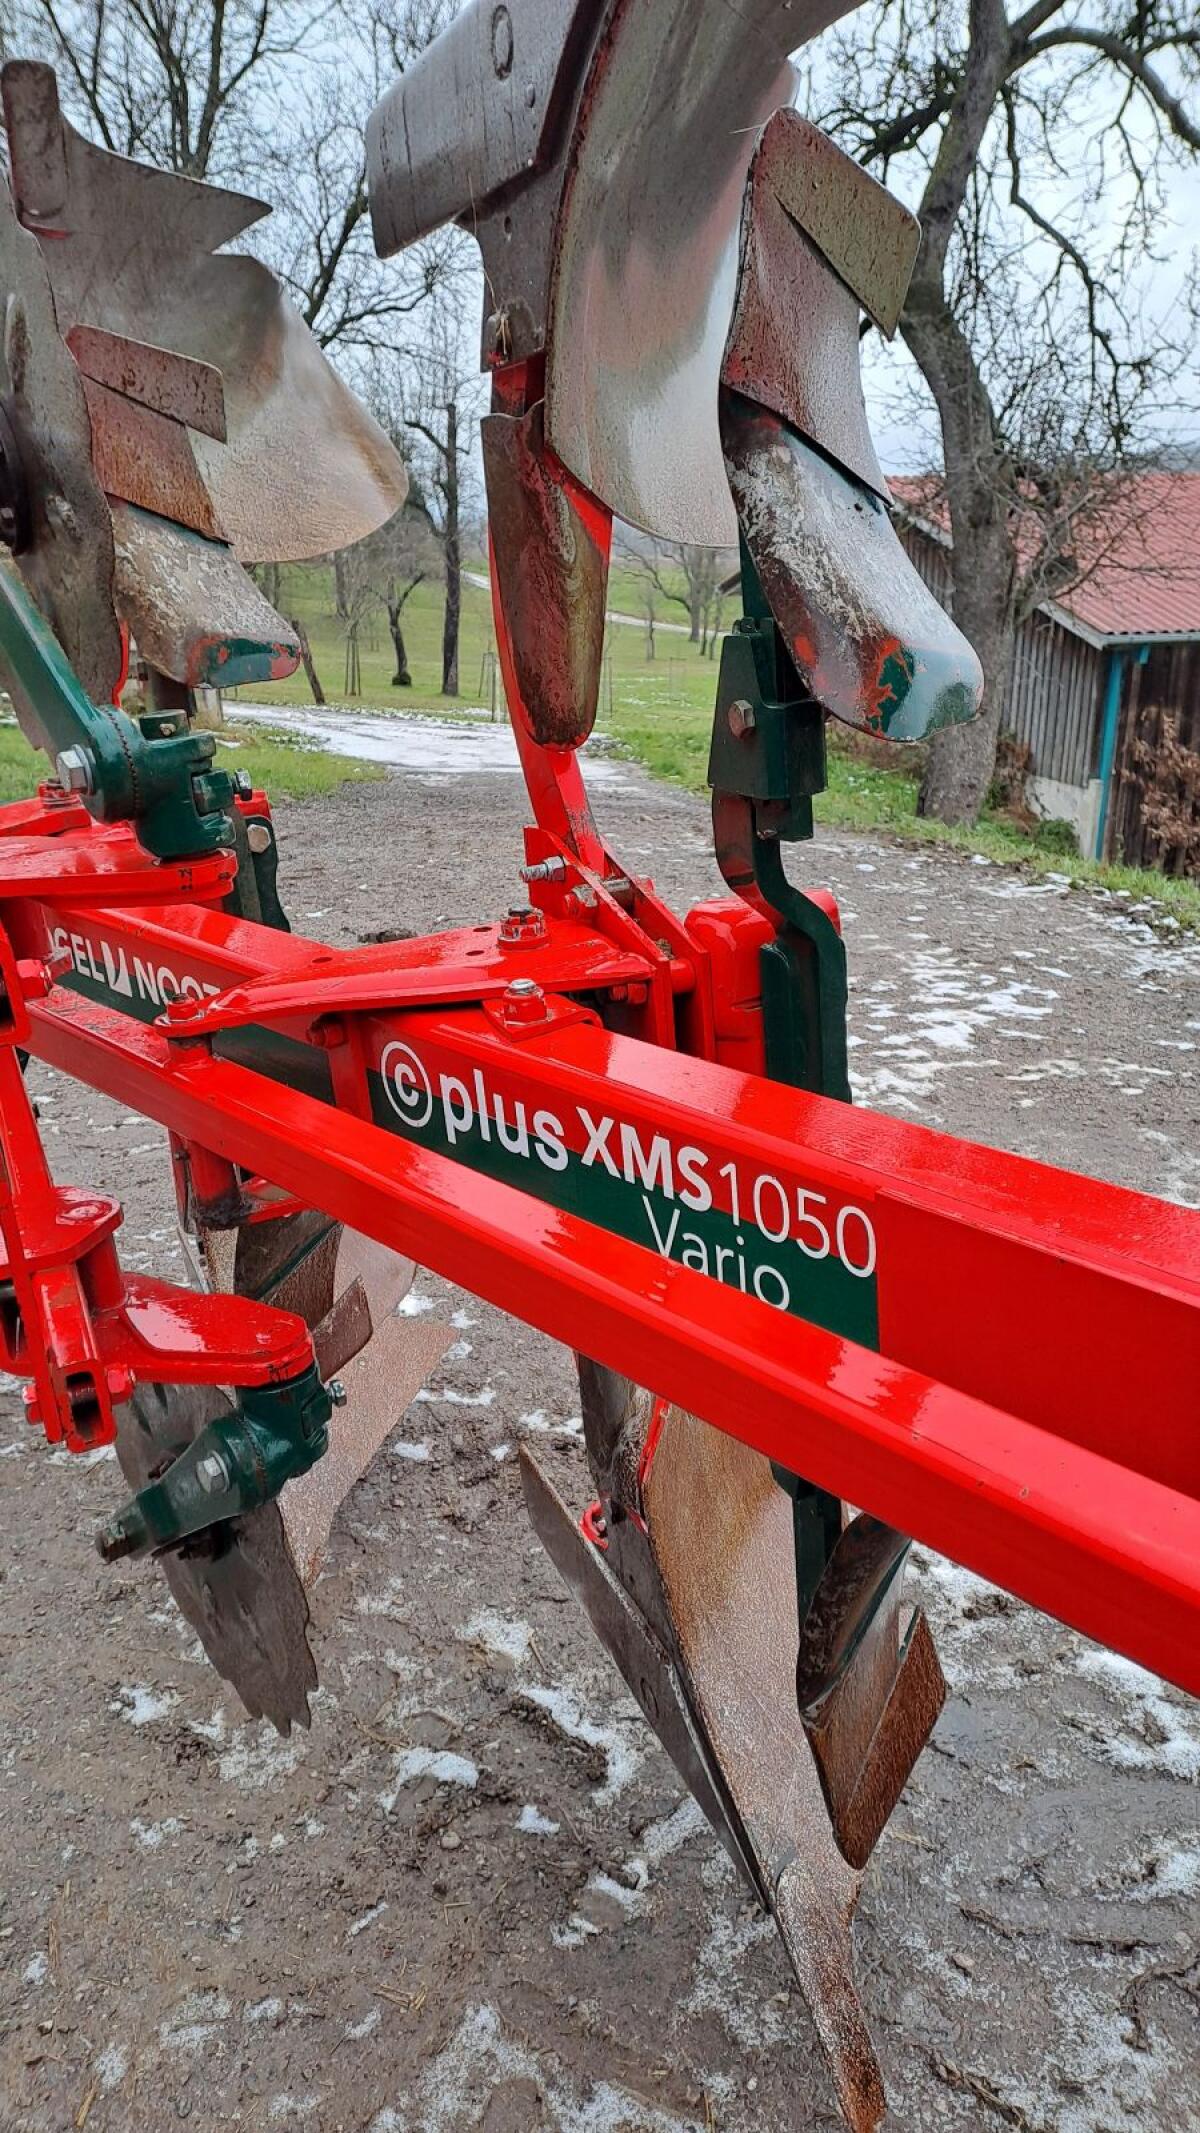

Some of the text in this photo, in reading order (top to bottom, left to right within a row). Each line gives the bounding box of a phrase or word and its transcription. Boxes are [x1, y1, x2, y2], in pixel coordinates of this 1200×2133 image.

[48, 927, 221, 1006] GEL NOO
[642, 1194, 790, 1311] Vario
